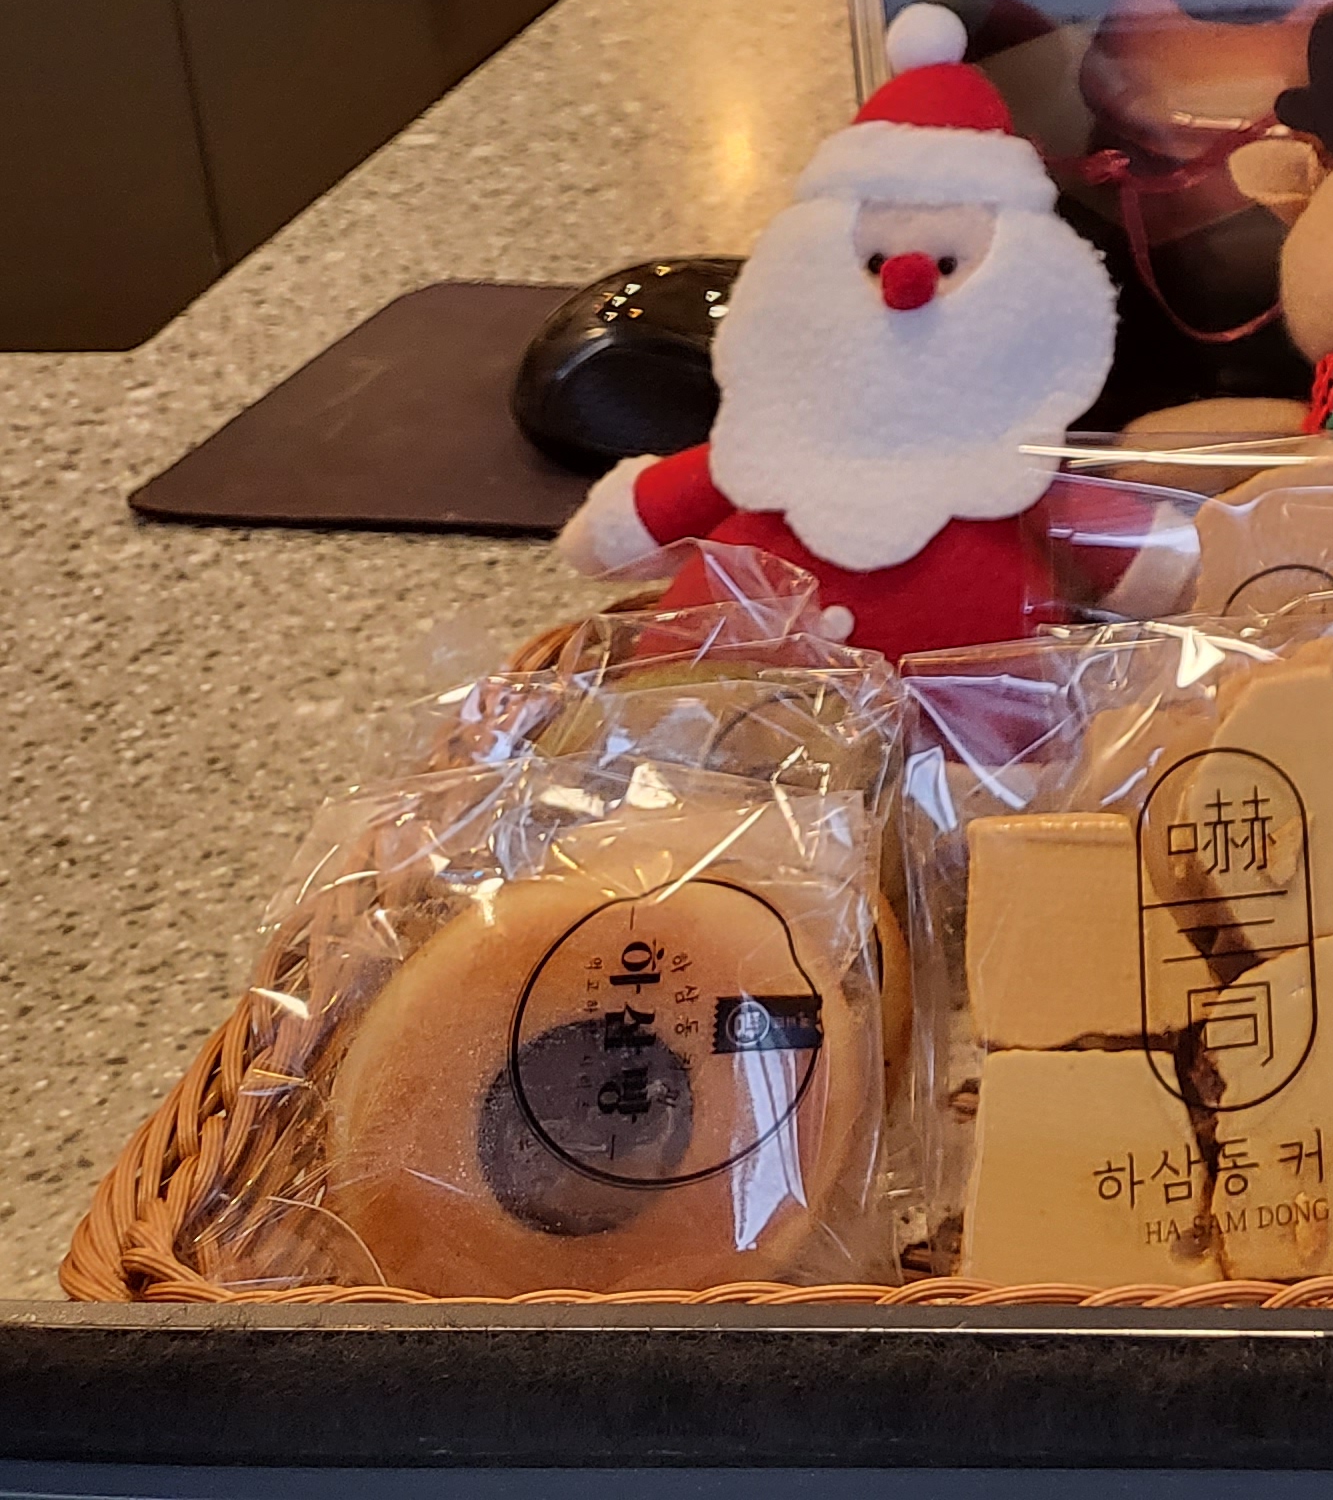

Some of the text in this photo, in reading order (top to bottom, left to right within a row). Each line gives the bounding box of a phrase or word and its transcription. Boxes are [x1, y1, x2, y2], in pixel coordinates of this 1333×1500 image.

[1145, 1199, 1330, 1245] HA SAM DONG
